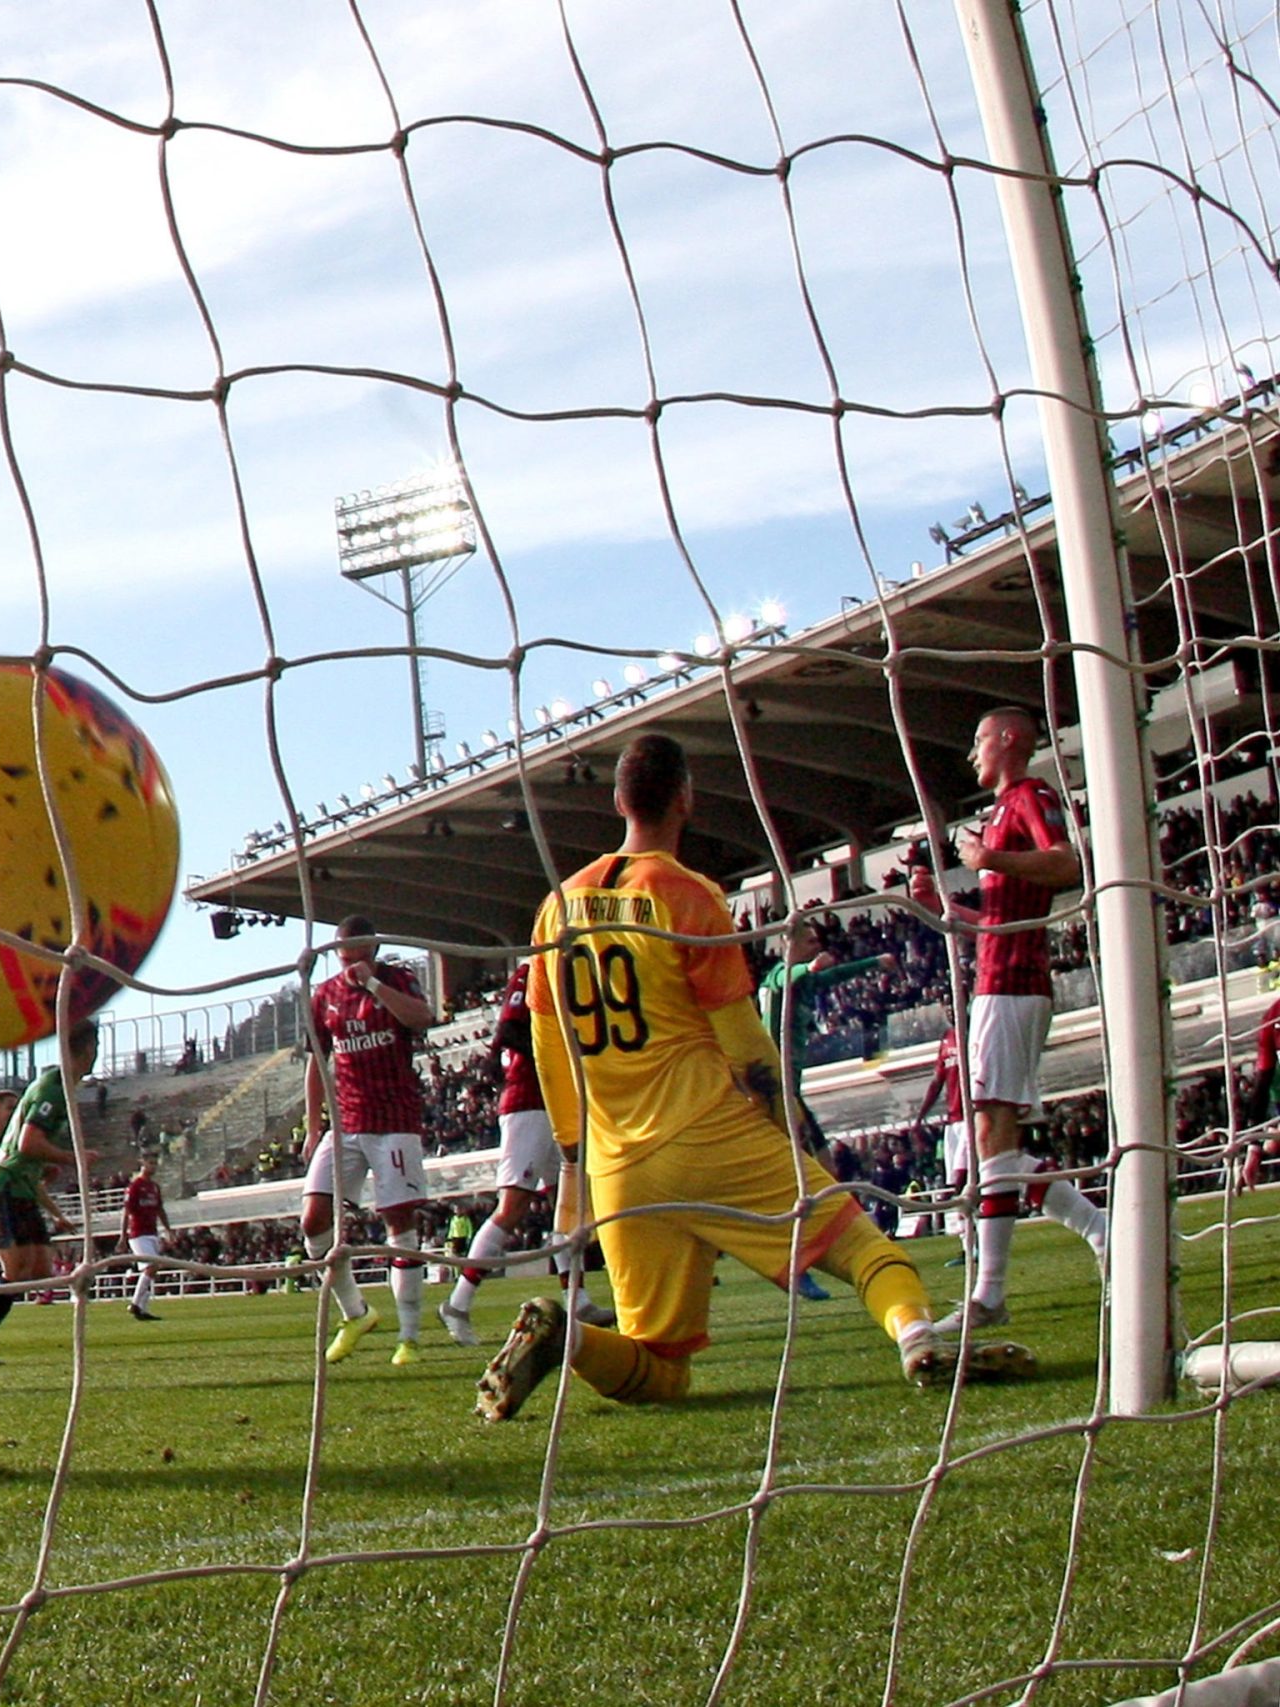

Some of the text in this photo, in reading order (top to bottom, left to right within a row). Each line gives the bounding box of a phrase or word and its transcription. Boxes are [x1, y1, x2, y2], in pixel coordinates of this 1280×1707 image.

[564, 944, 649, 1056] 99
[346, 1018, 366, 1034] Fly
[391, 1149, 405, 1176] 4
